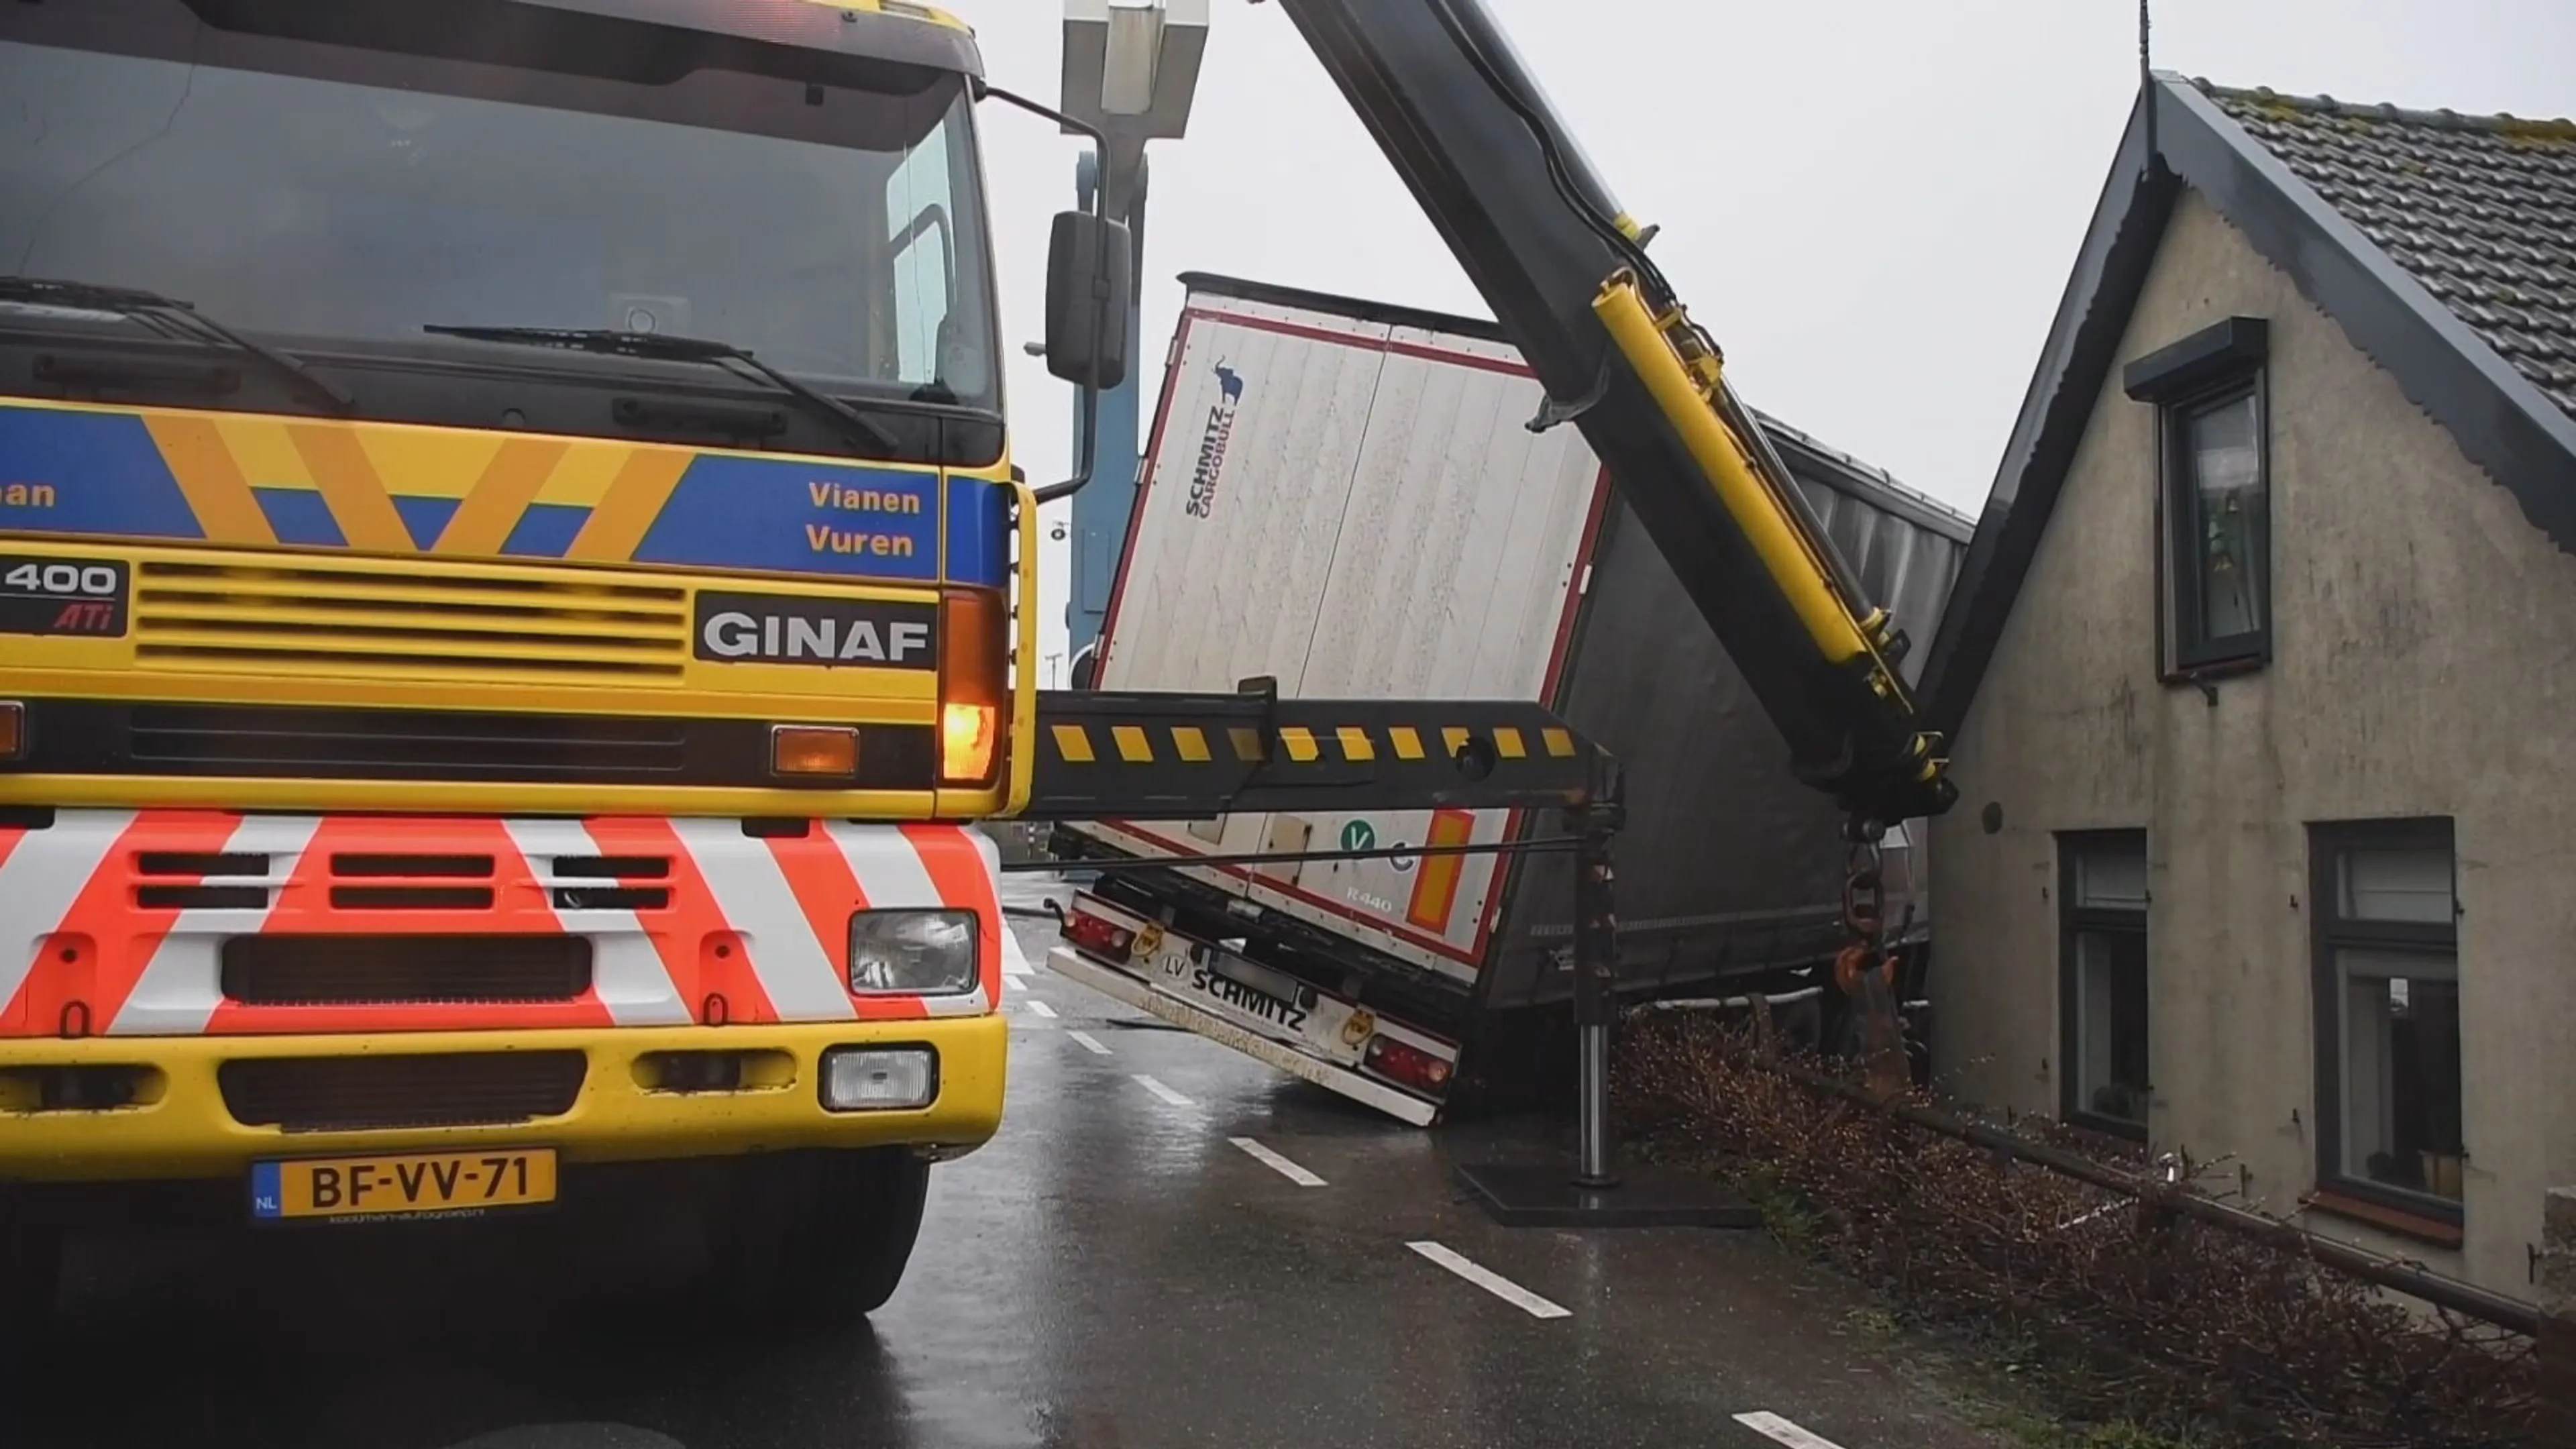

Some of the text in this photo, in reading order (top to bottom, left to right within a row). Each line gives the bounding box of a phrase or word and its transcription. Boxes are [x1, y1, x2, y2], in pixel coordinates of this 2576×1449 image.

[1186, 406, 1224, 517] SCHMITZ
[1199, 410, 1235, 519] CARGOBULL
[808, 482, 920, 514] Vianen
[806, 524, 913, 557] Vuren
[5, 564, 116, 594] 400
[704, 612, 928, 661] GINAF
[1165, 957, 1185, 977] LV
[1191, 969, 1307, 1033] SCHMITZ
[312, 1157, 527, 1208] BF-VV-71
[256, 1197, 277, 1210] NL
